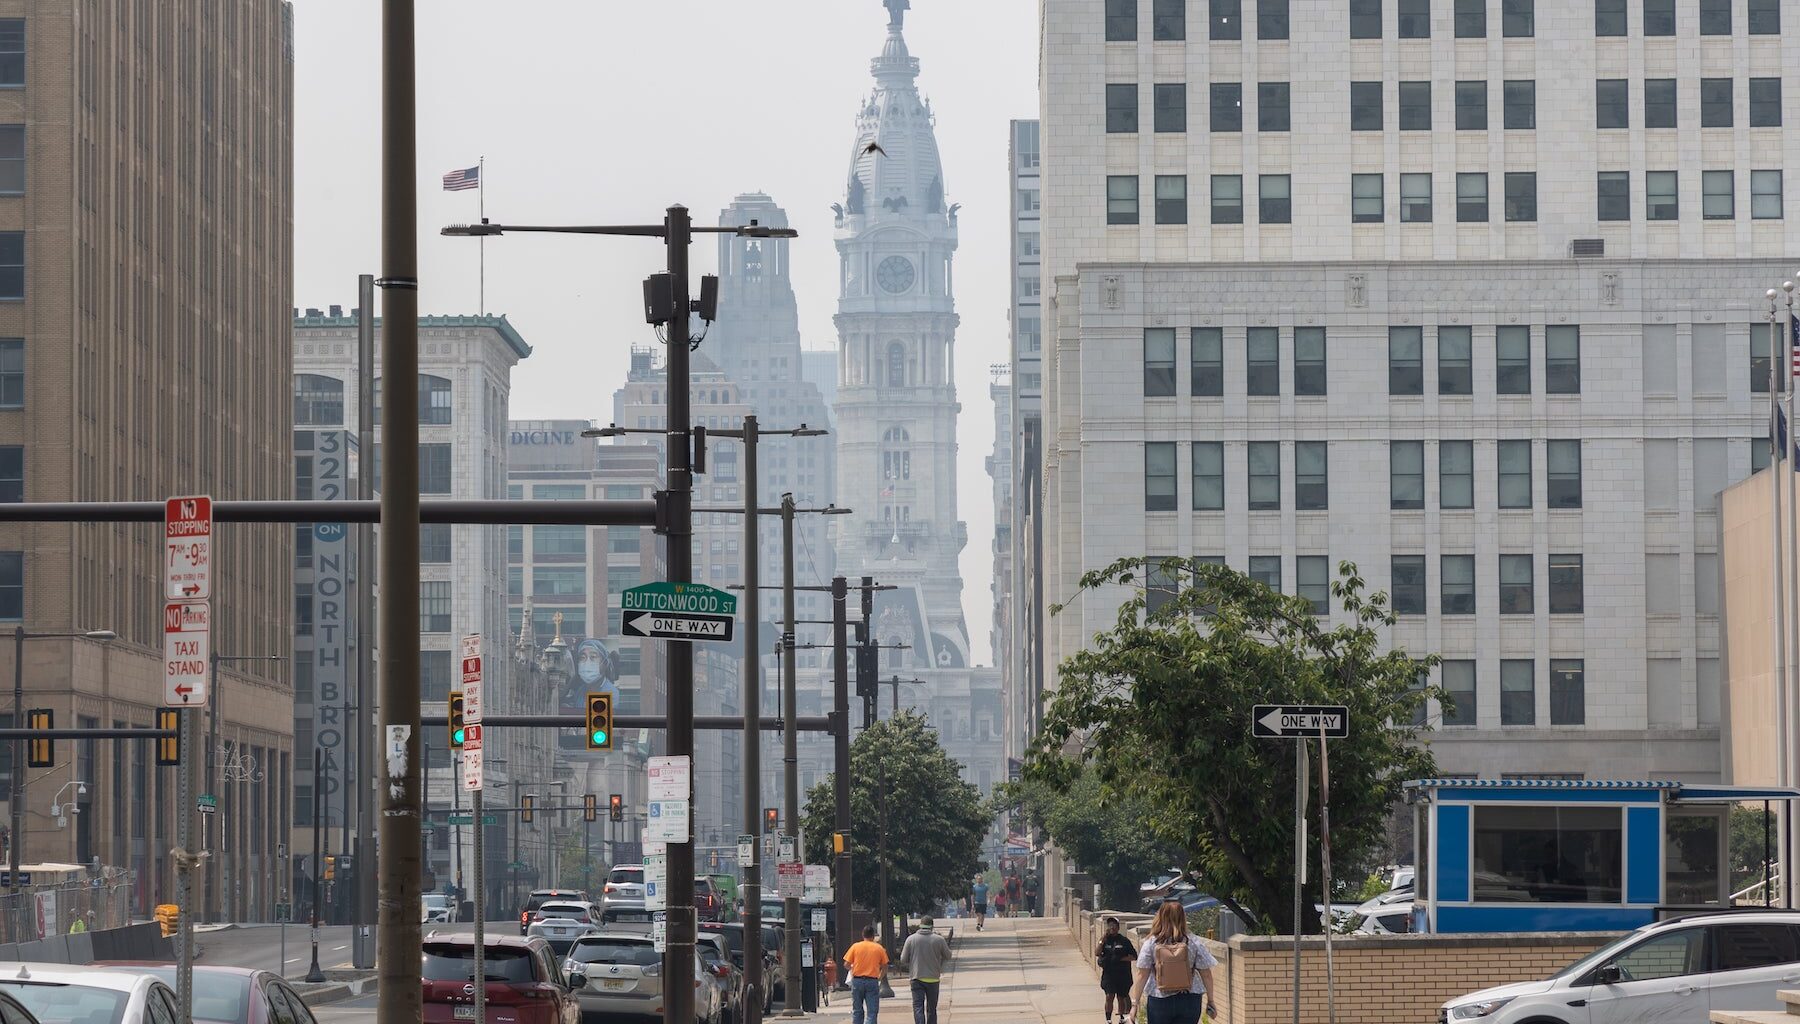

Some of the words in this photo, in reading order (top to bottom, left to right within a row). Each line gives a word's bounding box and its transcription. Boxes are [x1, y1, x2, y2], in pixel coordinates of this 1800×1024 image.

[180, 501, 197, 519] NO
[168, 519, 209, 535] STOPPING
[319, 524, 341, 535] ON
[675, 585, 684, 593] W
[625, 591, 718, 612] BUTTONWOOD
[722, 601, 734, 613] ST
[318, 554, 342, 667] NORTH
[166, 608, 181, 629] NO
[182, 611, 207, 625] PARKING
[653, 619, 683, 632] ONE
[688, 621, 719, 633] WAY
[174, 641, 199, 656] TAXI
[168, 660, 204, 676] STAND
[467, 659, 476, 672] NO
[466, 686, 478, 696] ANY
[467, 697, 478, 706] TIME
[1281, 715, 1307, 728] ONE
[1310, 715, 1337, 728] WAY
[317, 682, 342, 795] BROAD
